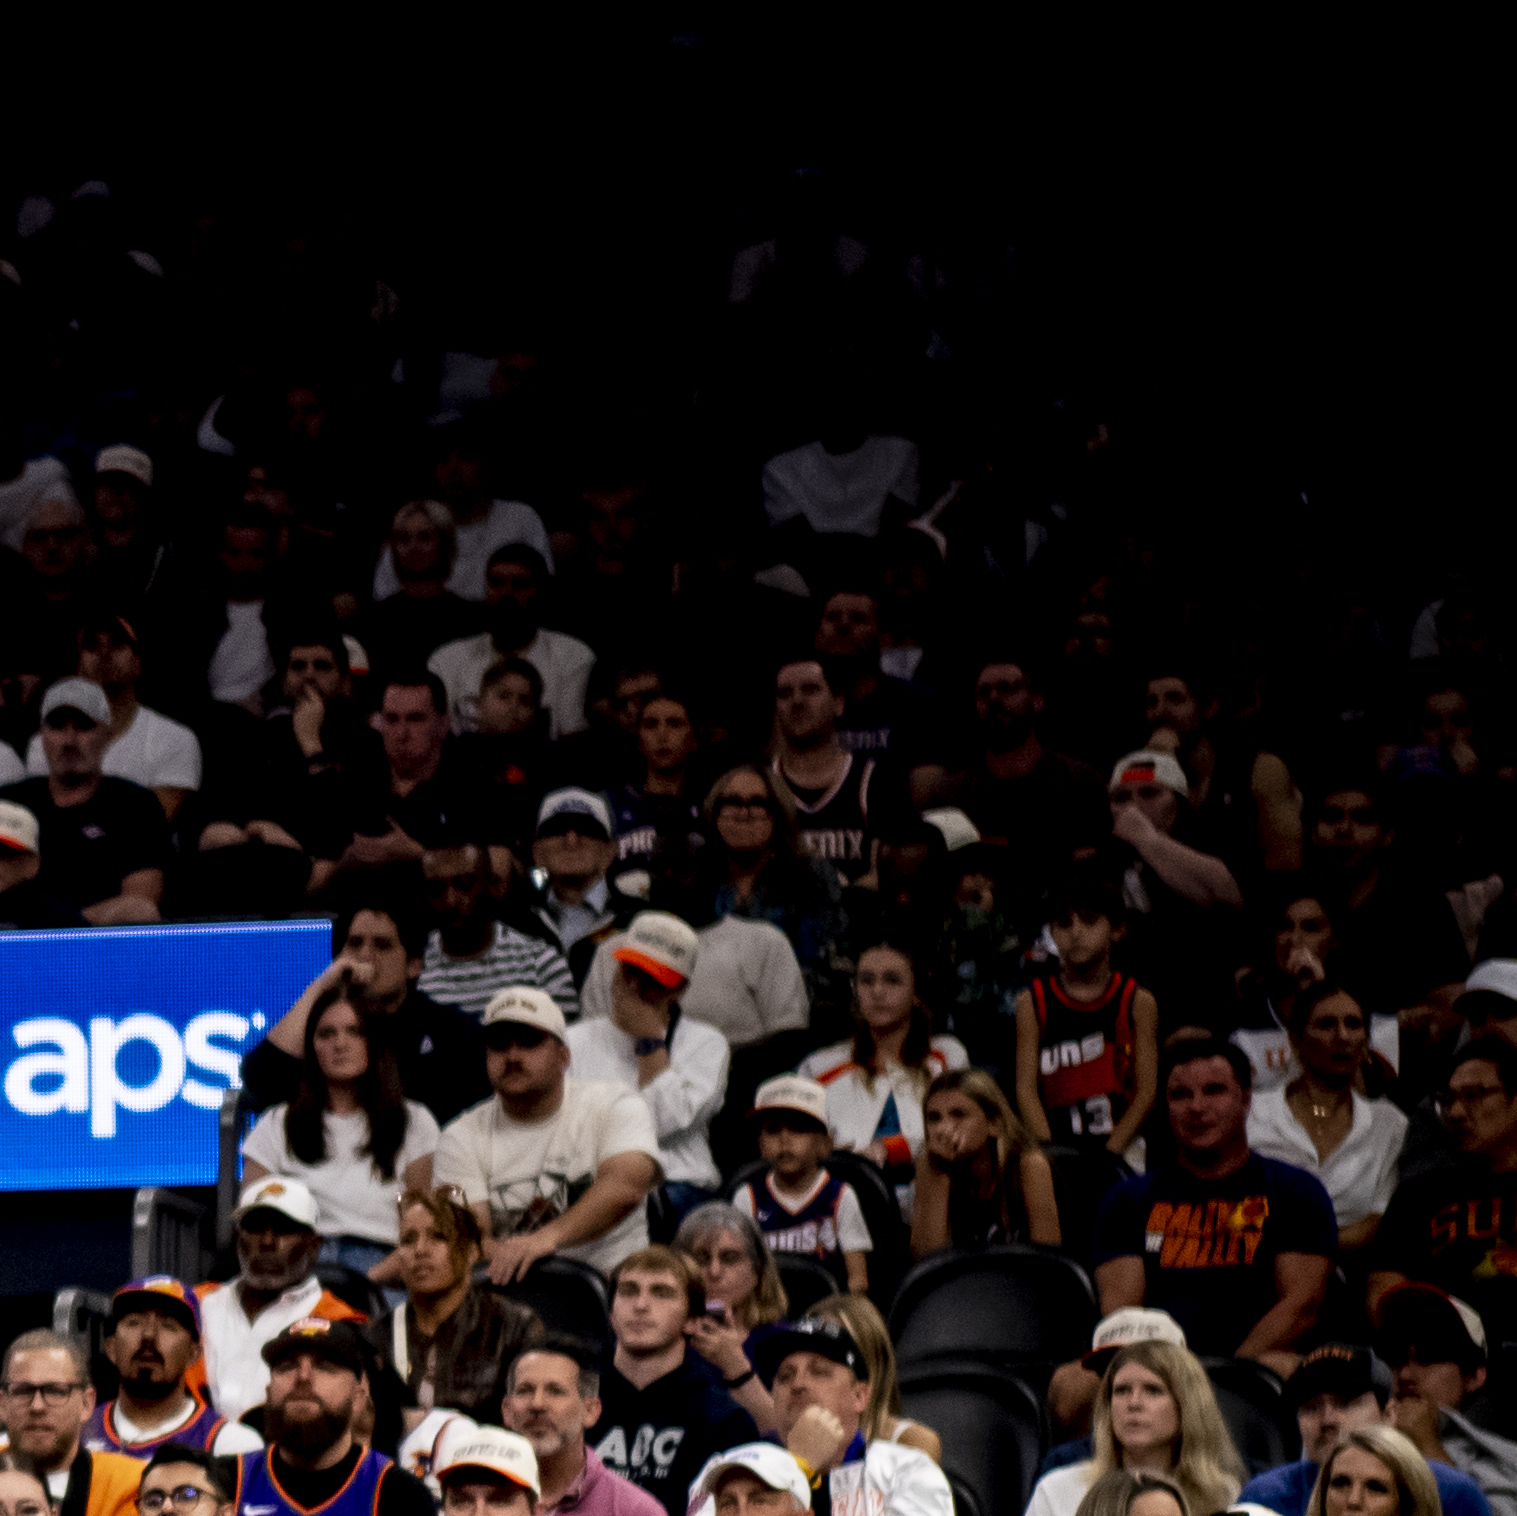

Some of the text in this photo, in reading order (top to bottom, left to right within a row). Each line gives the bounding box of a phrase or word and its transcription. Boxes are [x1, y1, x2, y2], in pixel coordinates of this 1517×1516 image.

[799, 828, 864, 859] ENIX
[2, 1009, 244, 1139] aps
[1428, 1196, 1517, 1257] SU
